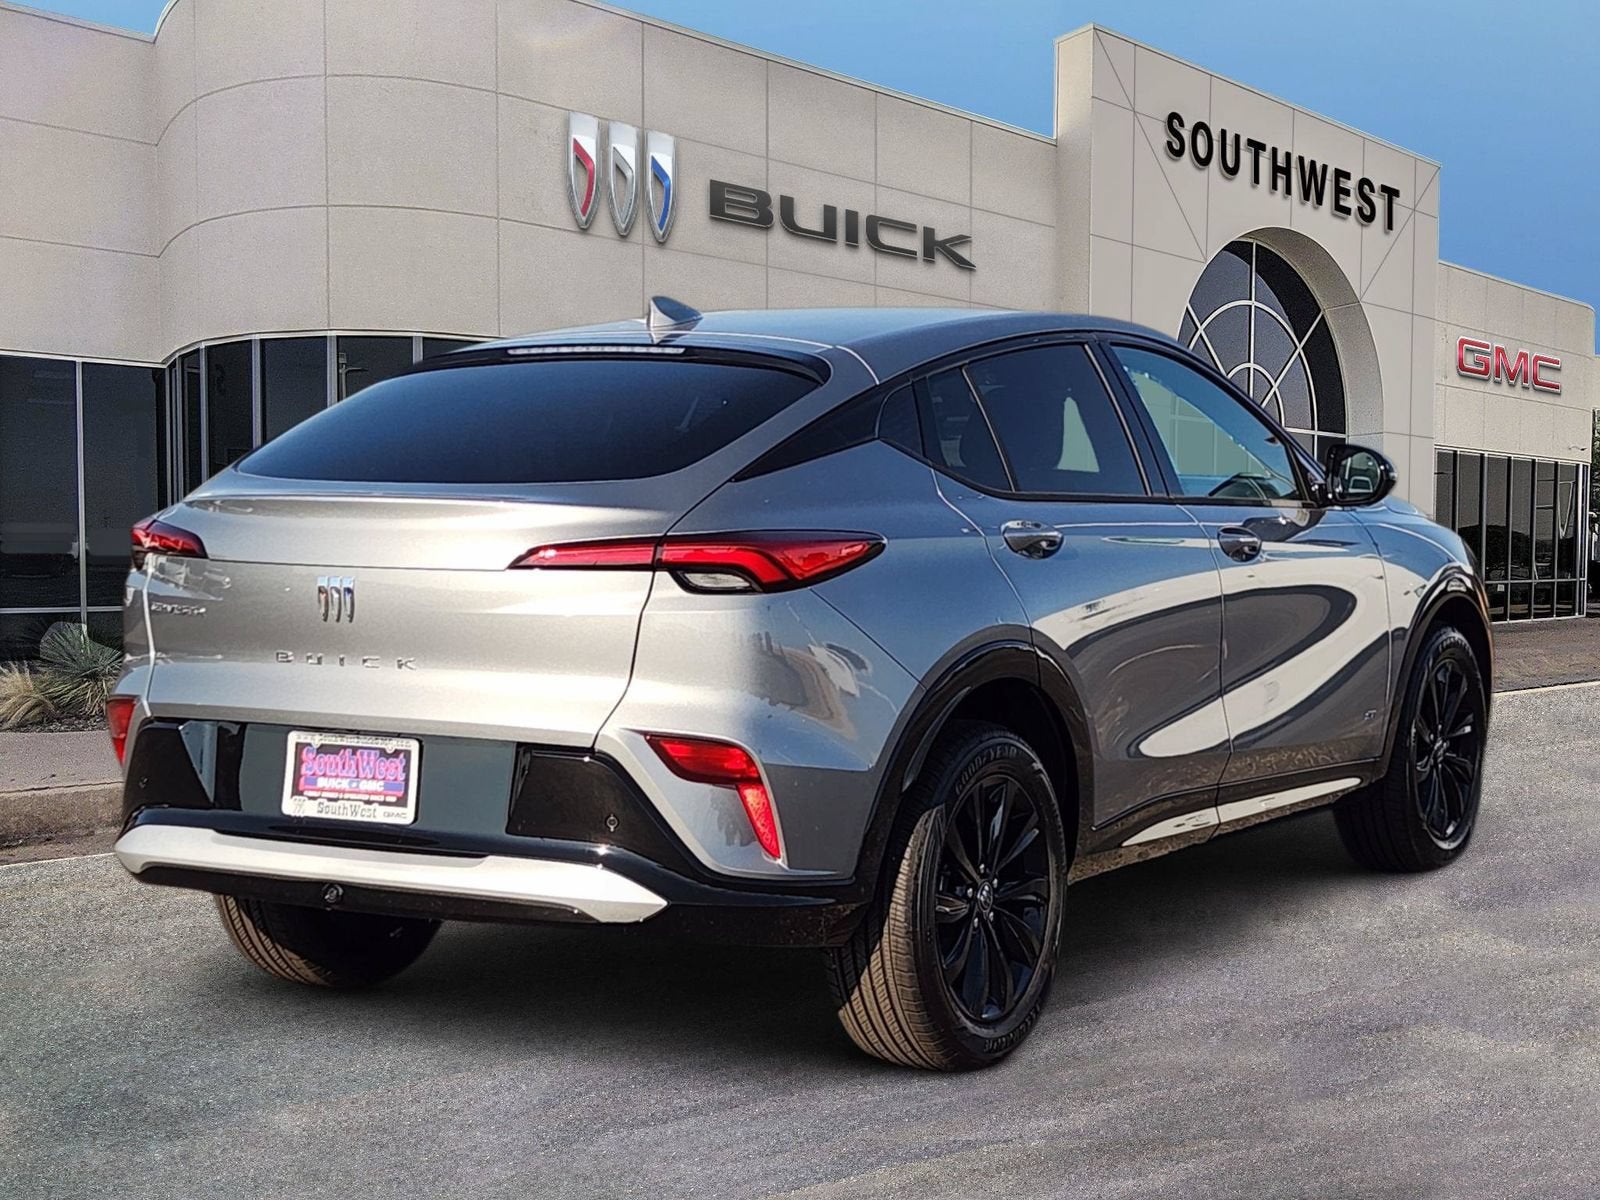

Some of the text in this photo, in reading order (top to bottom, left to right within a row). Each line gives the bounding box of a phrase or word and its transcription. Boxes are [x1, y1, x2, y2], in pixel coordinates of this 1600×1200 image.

[1165, 111, 1401, 231] SOUTHWEST
[708, 178, 977, 271] BUICK
[1455, 335, 1562, 394] GMC
[275, 649, 417, 671] BUICK
[301, 745, 407, 781] SouthWest
[358, 779, 385, 792] GMC
[316, 801, 378, 819] SouthWest
